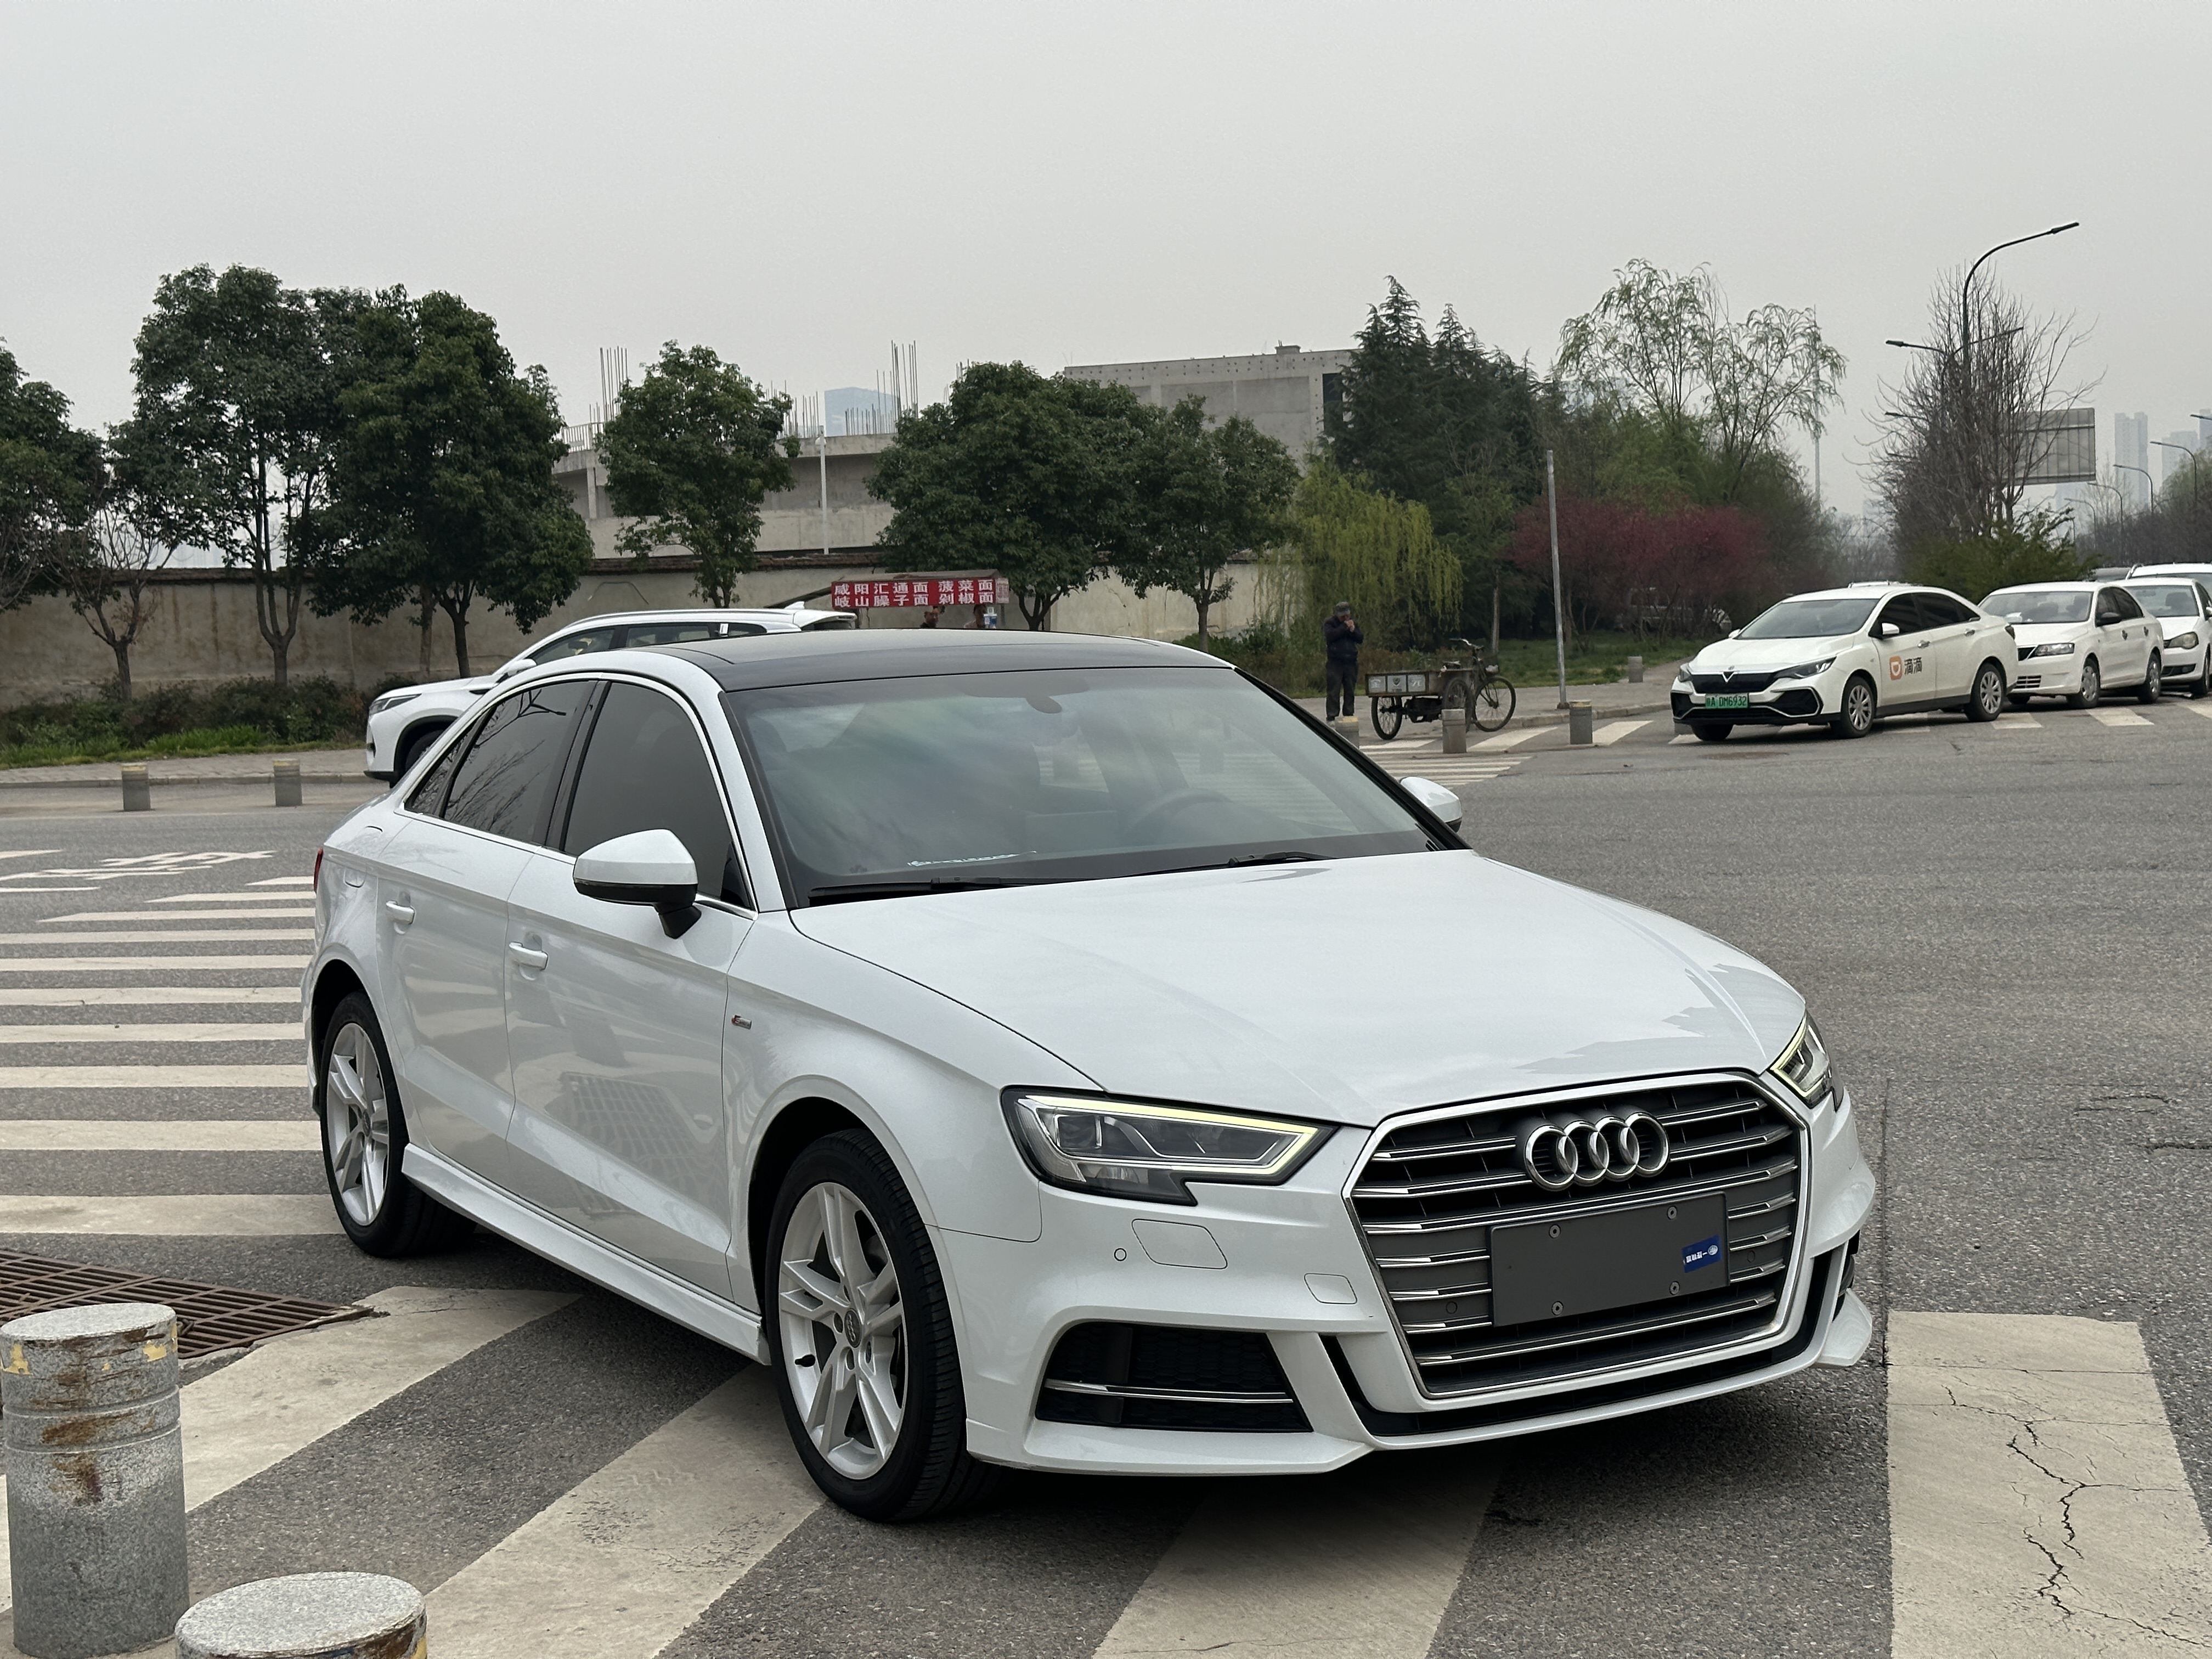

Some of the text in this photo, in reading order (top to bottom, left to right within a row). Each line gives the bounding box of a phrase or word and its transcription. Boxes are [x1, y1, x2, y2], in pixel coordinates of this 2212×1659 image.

[834, 582, 928, 595] 咸阳汇通面
[938, 579, 993, 592] 菠菜面
[939, 591, 994, 605] 剁椒面
[1904, 657, 1922, 675] 滴滴
